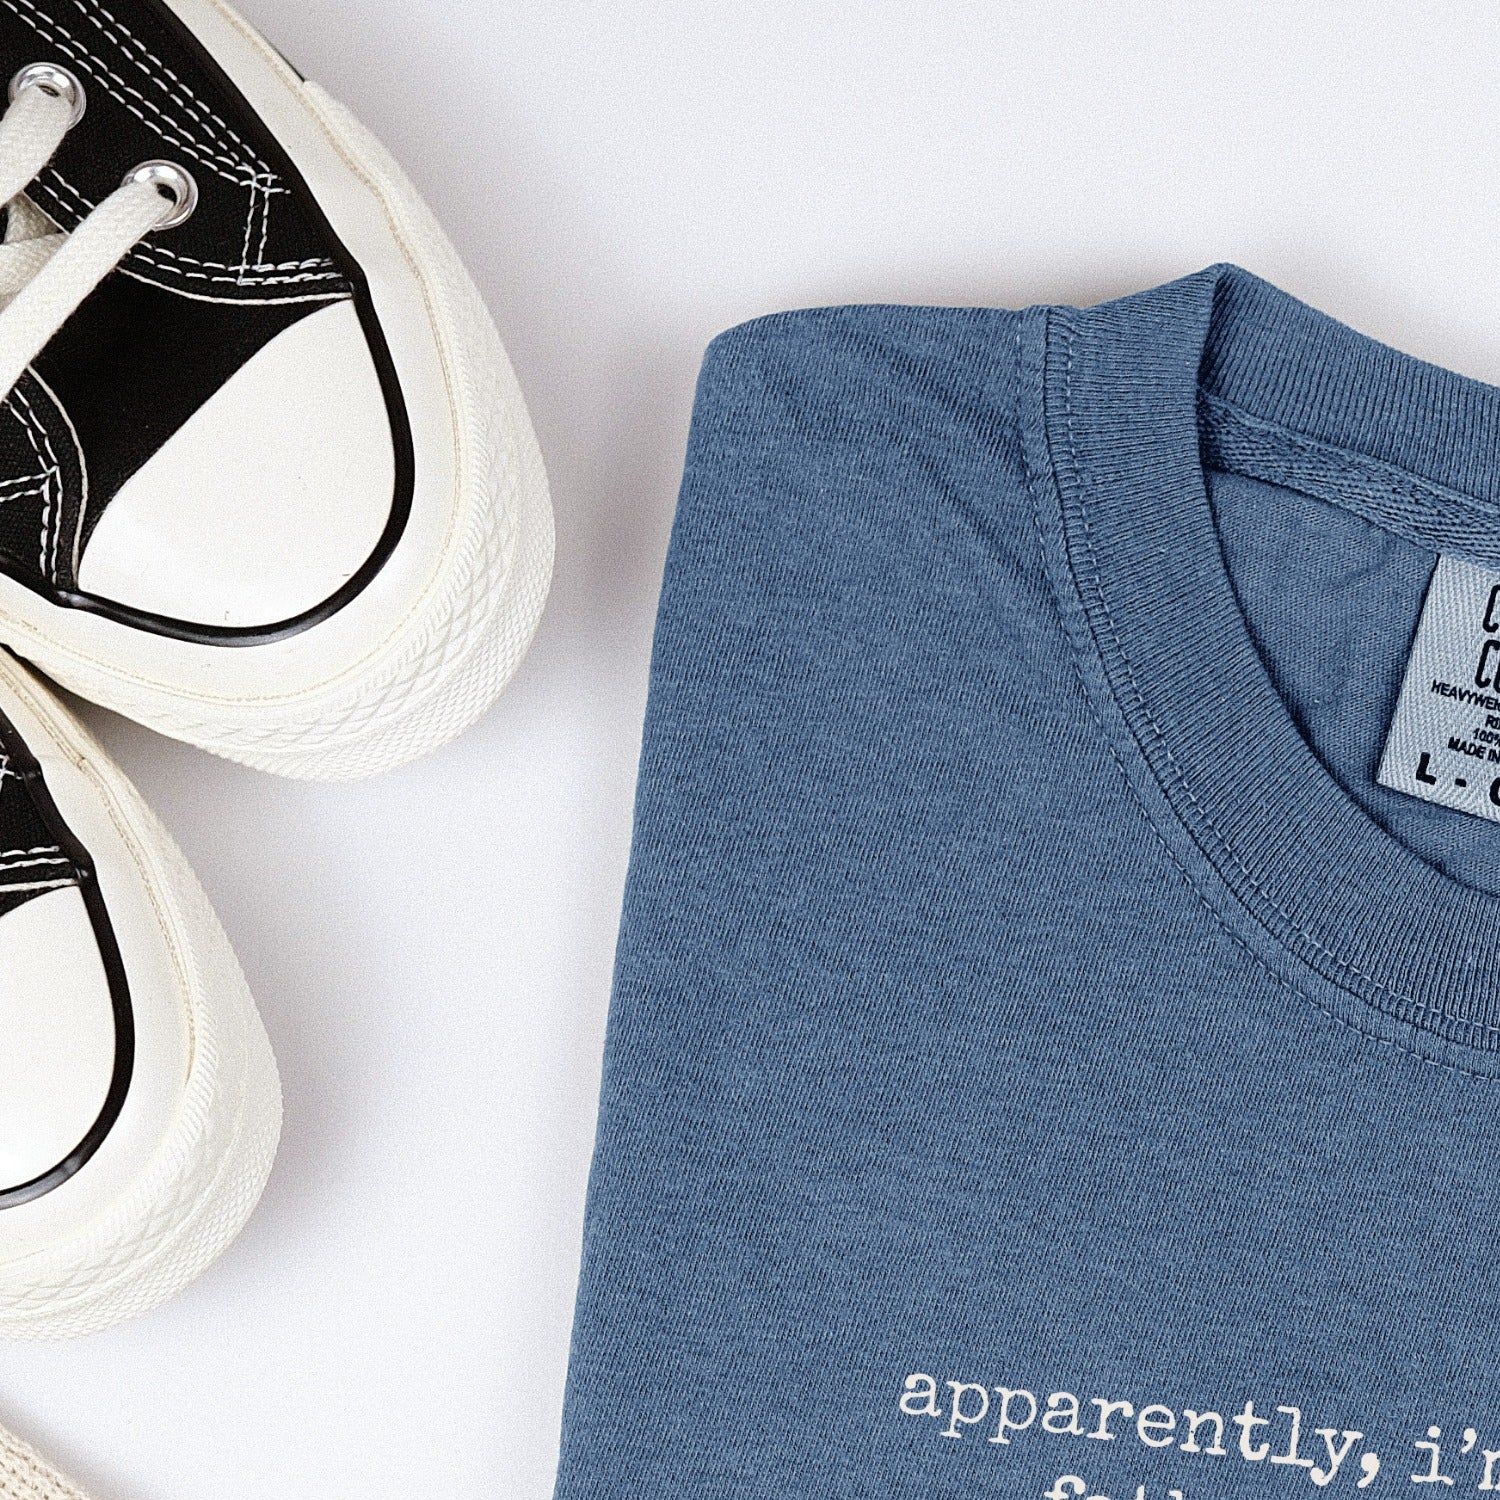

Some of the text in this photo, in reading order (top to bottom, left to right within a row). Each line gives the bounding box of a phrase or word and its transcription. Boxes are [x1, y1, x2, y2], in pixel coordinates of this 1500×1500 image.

[1448, 736, 1484, 760] MADE
[1488, 749, 1500, 764] IN
[1416, 752, 1436, 785] L
[900, 1373, 1380, 1488] apparently,
